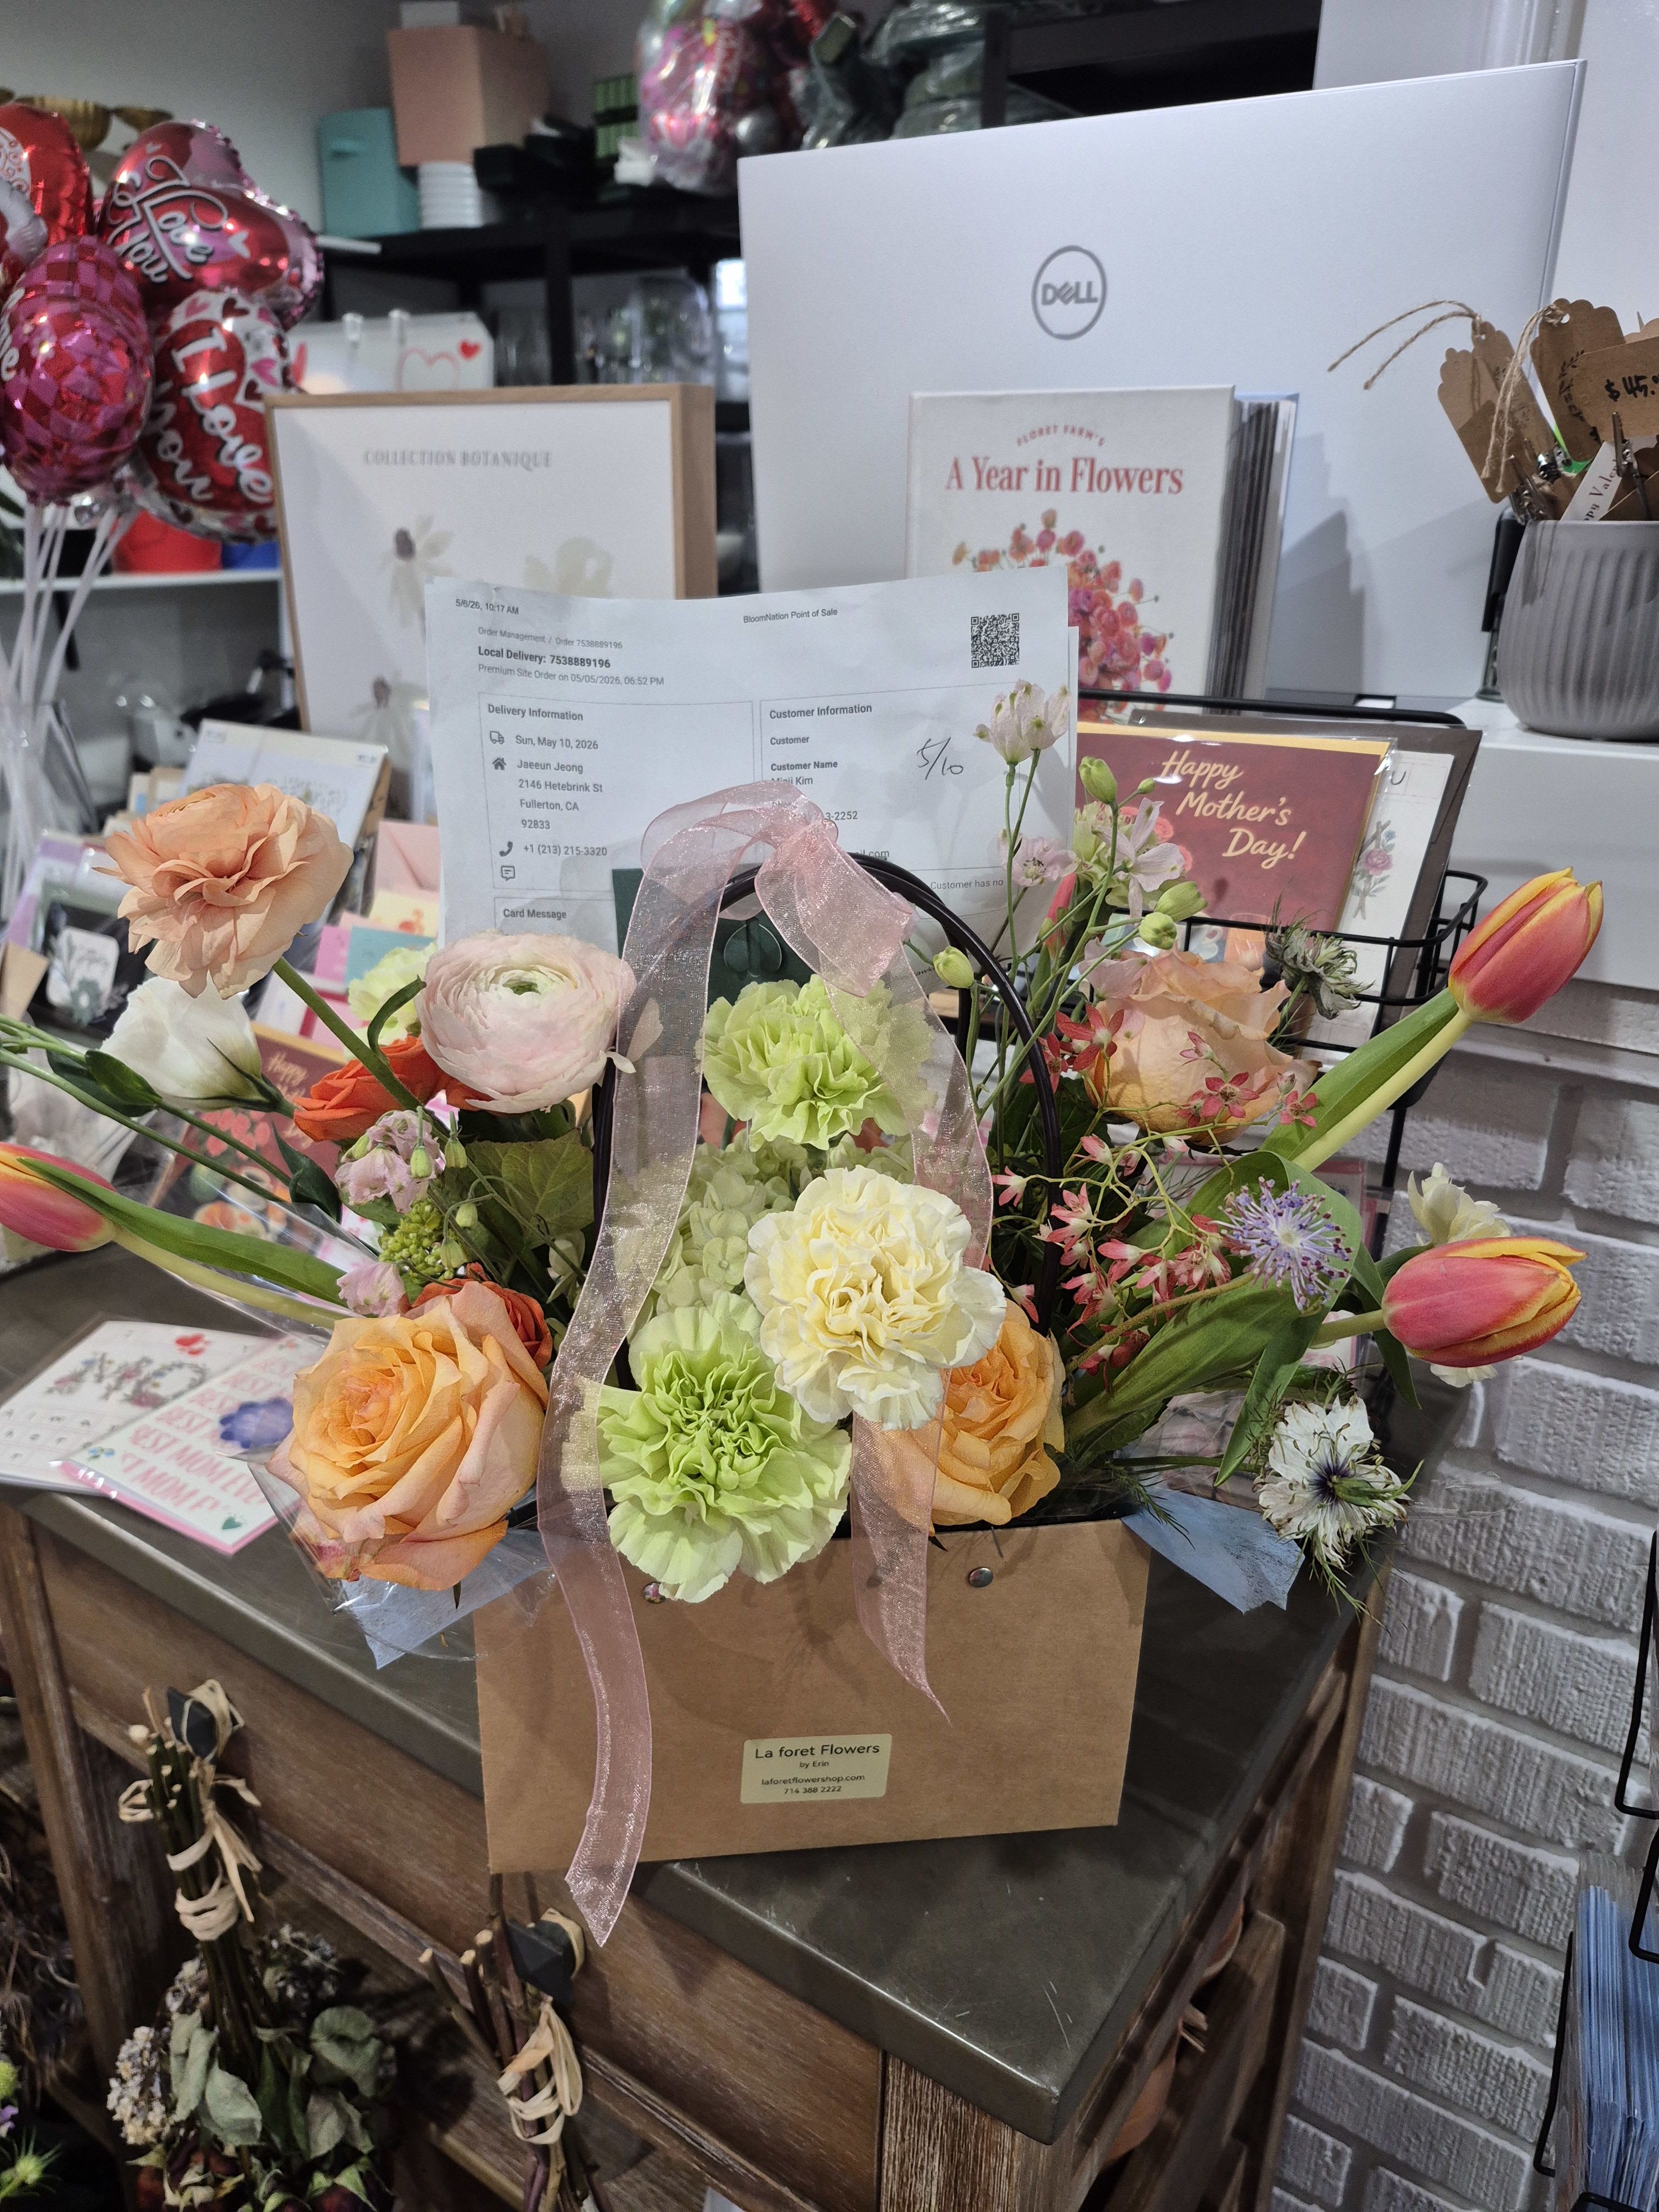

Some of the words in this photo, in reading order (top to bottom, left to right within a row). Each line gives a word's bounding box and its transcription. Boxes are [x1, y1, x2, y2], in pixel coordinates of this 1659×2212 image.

[142, 190, 228, 279] Love
[1041, 280, 1099, 306] DELL
[171, 327, 228, 373] I
[945, 456, 964, 491] A
[972, 456, 1029, 491] Year
[1035, 458, 1061, 492] in
[1070, 457, 1183, 495] Flowers
[455, 598, 483, 611] 5/6/26,
[486, 603, 505, 613] 10:17
[507, 606, 519, 615] AM
[743, 612, 789, 624] BloomNation
[791, 610, 810, 619] Point
[812, 609, 819, 617] of
[821, 608, 838, 617] Sale
[478, 627, 498, 637] Order
[500, 630, 546, 643] Management
[555, 637, 574, 646] Order
[478, 646, 504, 658] Local
[507, 649, 546, 665] Delivery:
[550, 654, 611, 669] 7538889196
[478, 664, 515, 676] Premium
[517, 668, 533, 678] Site
[534, 670, 556, 681] Order
[571, 673, 623, 686] 05/05/2026,
[624, 676, 648, 686] 06:52
[650, 677, 664, 686] PM
[488, 703, 526, 718] Delivery
[529, 707, 584, 721] Information
[769, 708, 815, 719] Customer
[817, 704, 873, 717] Information
[515, 734, 535, 747] Sun,
[538, 737, 557, 749] May
[560, 738, 573, 750] 10,
[575, 739, 599, 750] 2026
[770, 735, 810, 745] Customer
[517, 759, 551, 771] Jaeeun
[554, 762, 584, 775] Jeong
[770, 763, 811, 771] Customer
[813, 760, 838, 769] Name
[916, 737, 964, 781] 5/10
[1160, 749, 1244, 790] Happy
[518, 779, 542, 790] 2146
[545, 780, 591, 792] Hetebrink
[592, 783, 603, 793] St
[795, 776, 813, 786] Kim
[520, 799, 564, 812] Fullerton,
[565, 801, 580, 811] CA
[1175, 791, 1292, 827] Mother's
[521, 819, 551, 830] 92833
[523, 844, 534, 853] +1
[538, 844, 561, 857] (213)
[564, 846, 608, 856] 215-3320
[1221, 828, 1308, 869] Day!
[930, 881, 972, 890] Customer
[974, 880, 990, 888] has
[503, 908, 525, 919] Card
[527, 909, 567, 921] Message
[755, 1747, 773, 1759] La
[779, 1745, 816, 1757] foret
[821, 1743, 880, 1755] Flowers
[800, 1761, 810, 1769] by
[761, 1773, 865, 1786] laforetflowershop.com
